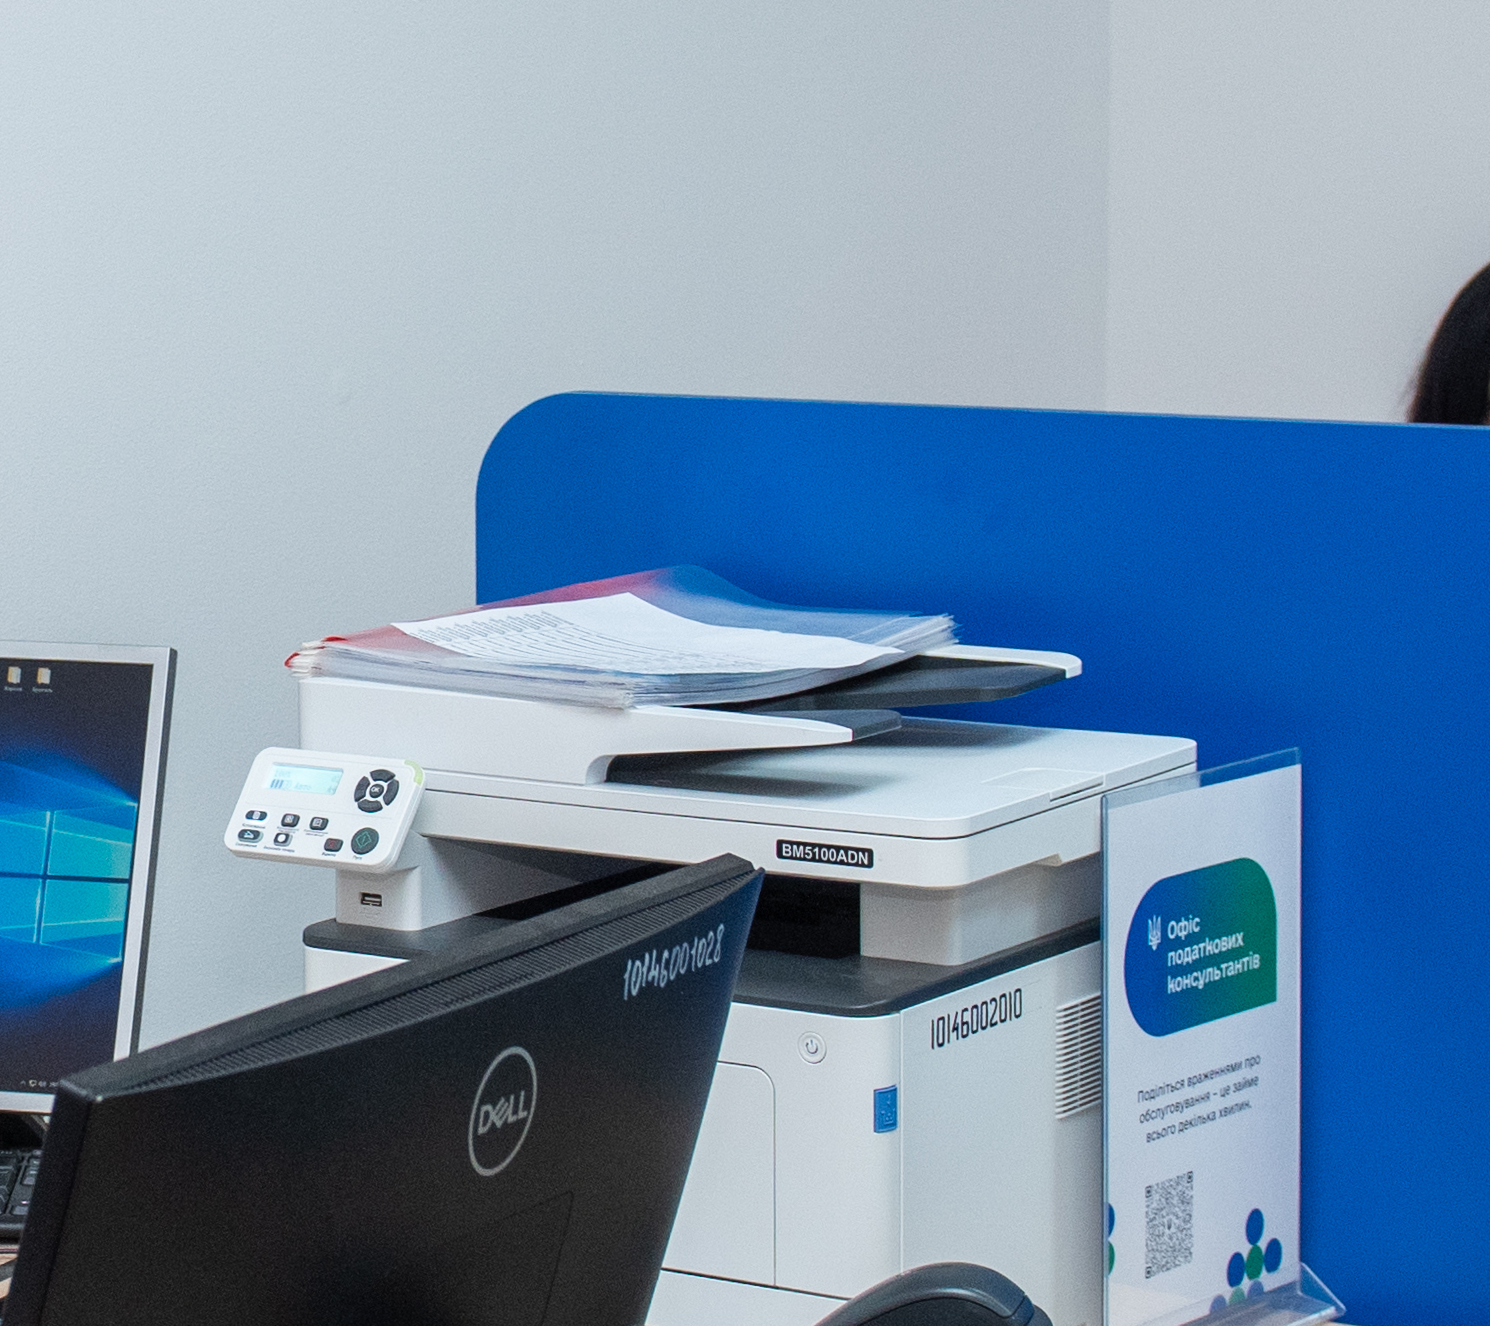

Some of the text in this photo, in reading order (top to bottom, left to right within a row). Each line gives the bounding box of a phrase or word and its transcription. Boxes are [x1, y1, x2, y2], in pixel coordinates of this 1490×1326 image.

[781, 842, 871, 867] BM5100ADN
[1168, 915, 1200, 940] Офіс
[1168, 931, 1244, 967] податкових
[623, 923, 724, 1001] 10146001028
[1167, 951, 1261, 994] консультантів
[931, 988, 1022, 1050] 10146002010
[1137, 1055, 1261, 1103] Поділіться враженнями про
[1139, 1091, 1211, 1124] обслуговування
[1219, 1086, 1231, 1099] це
[1233, 1075, 1259, 1093] займе
[477, 1094, 528, 1135] DELL
[1146, 1099, 1252, 1143] всього декілька хвилин.
